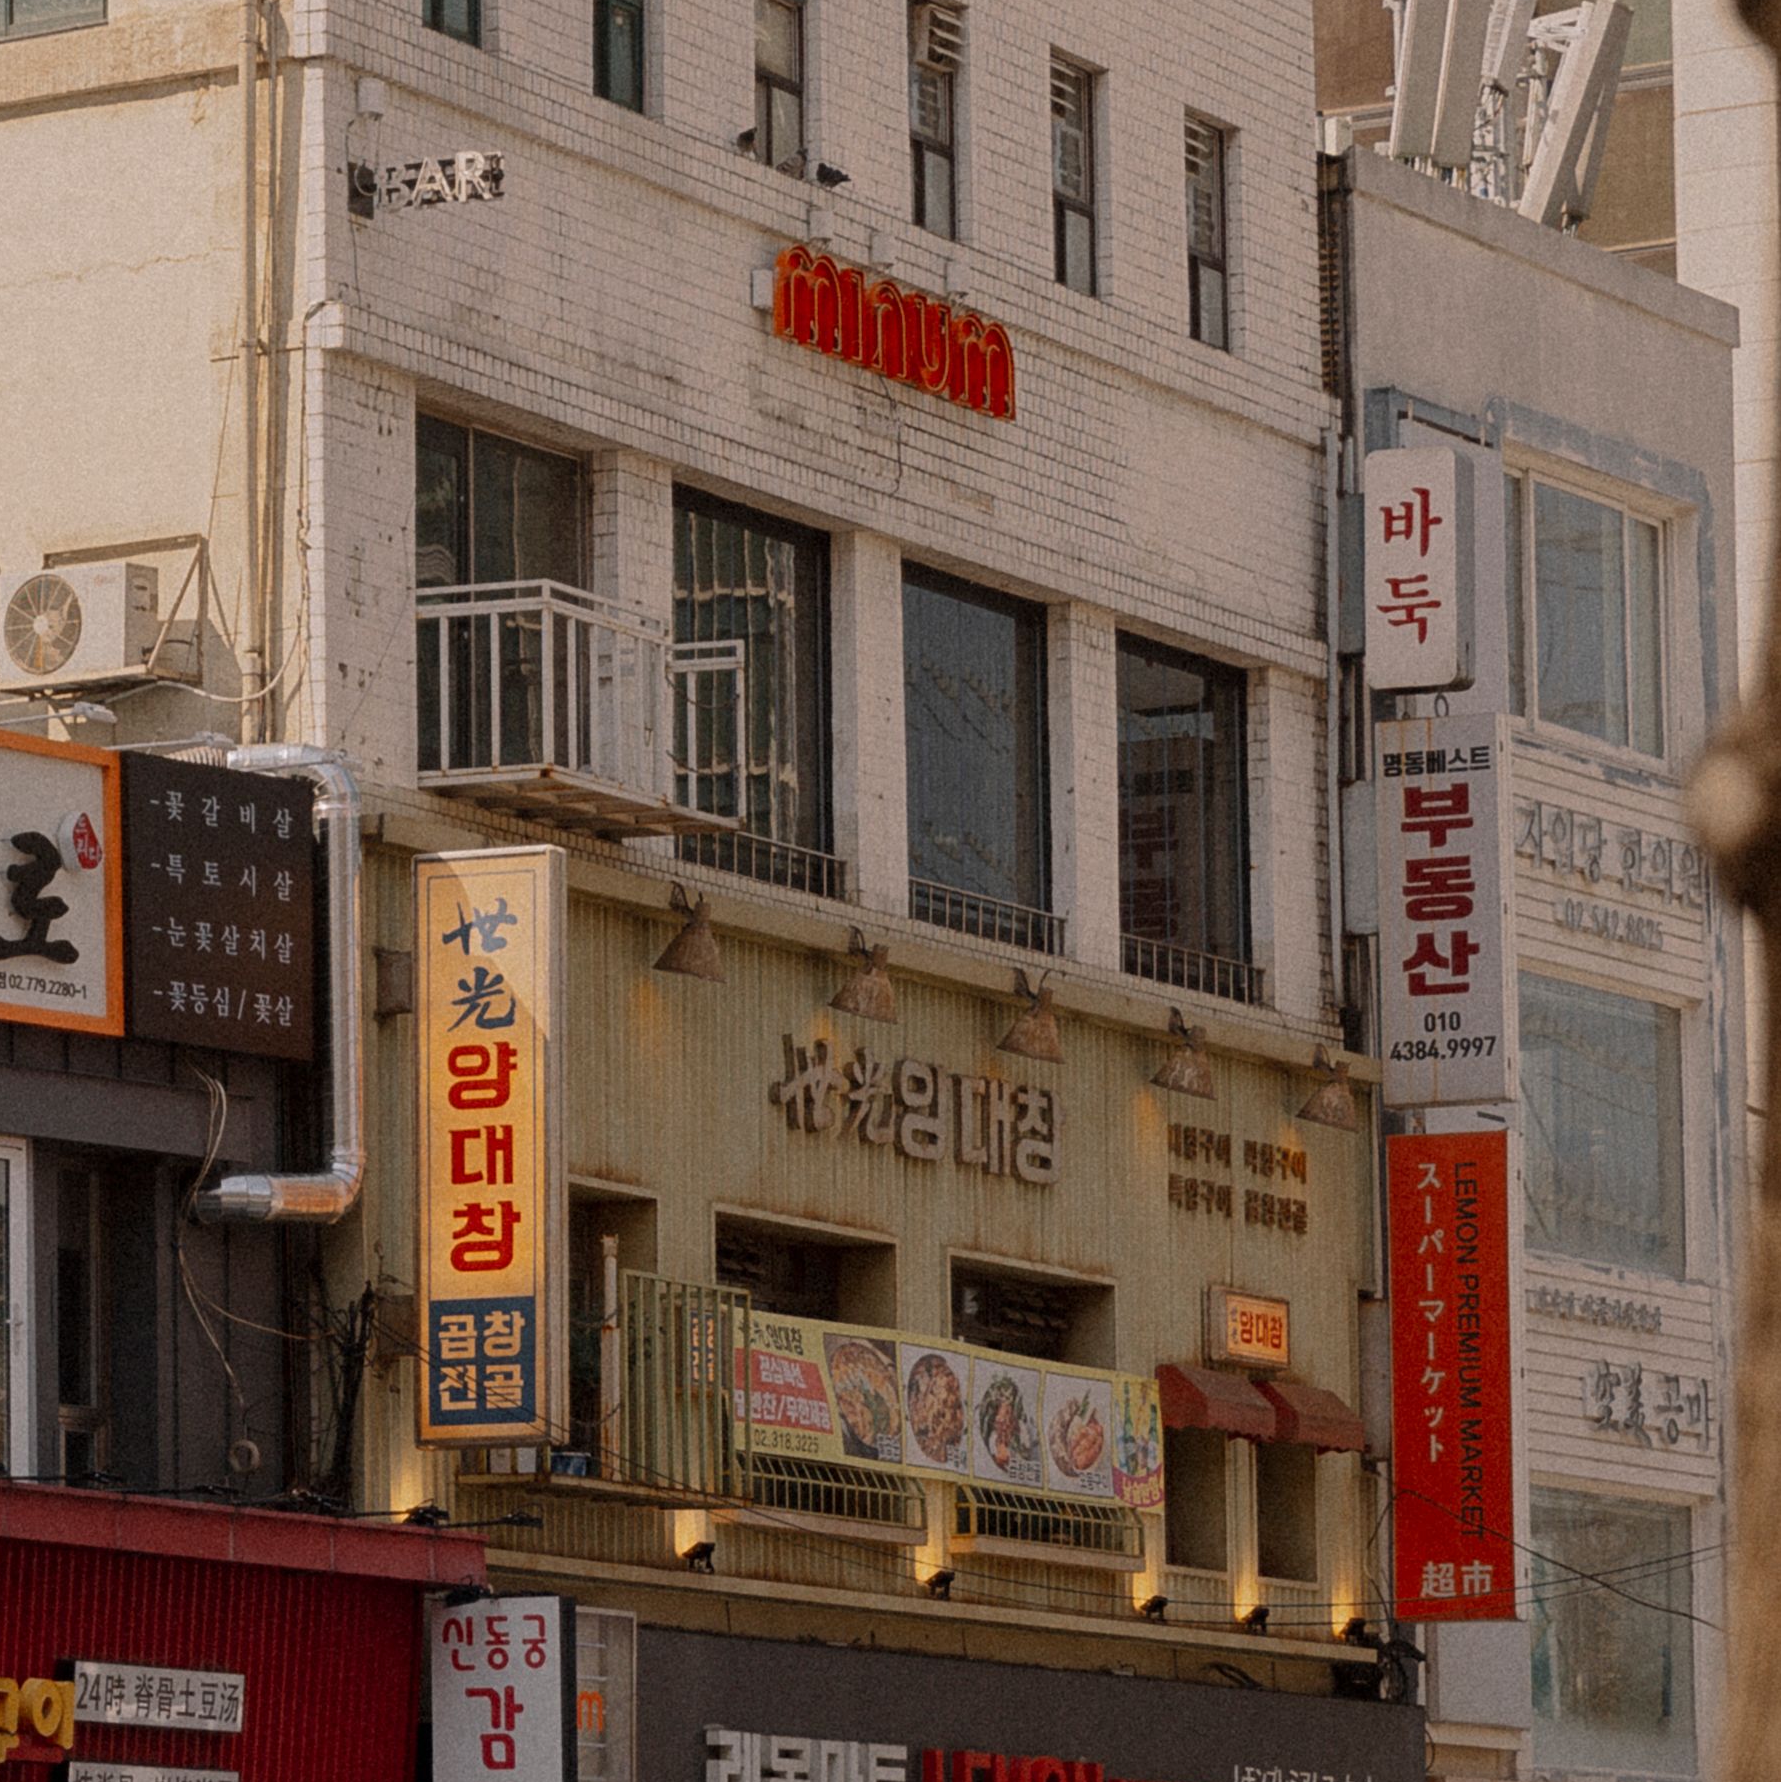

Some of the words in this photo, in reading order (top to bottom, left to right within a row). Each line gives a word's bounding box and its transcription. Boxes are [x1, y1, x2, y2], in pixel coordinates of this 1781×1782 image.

[1376, 486, 1443, 644] 바둑
[1383, 746, 1491, 778] 명동베스트
[1399, 782, 1480, 996] 부동산
[1389, 1036, 1497, 1063] 4384.9997
[1424, 1011, 1461, 1032] 010
[447, 1041, 521, 1273] 양대창
[1453, 1161, 1480, 1266] LEMON
[438, 1312, 526, 1360] 곱창
[1418, 1161, 1447, 1465] スーパーマーケット
[1455, 1274, 1482, 1411] PREMIUM
[438, 1365, 525, 1411] 전골
[1458, 1420, 1485, 1540] MARKET
[1421, 1560, 1494, 1599] 超市
[442, 1613, 548, 1672] 신동궁
[76, 1671, 125, 1718] 24時
